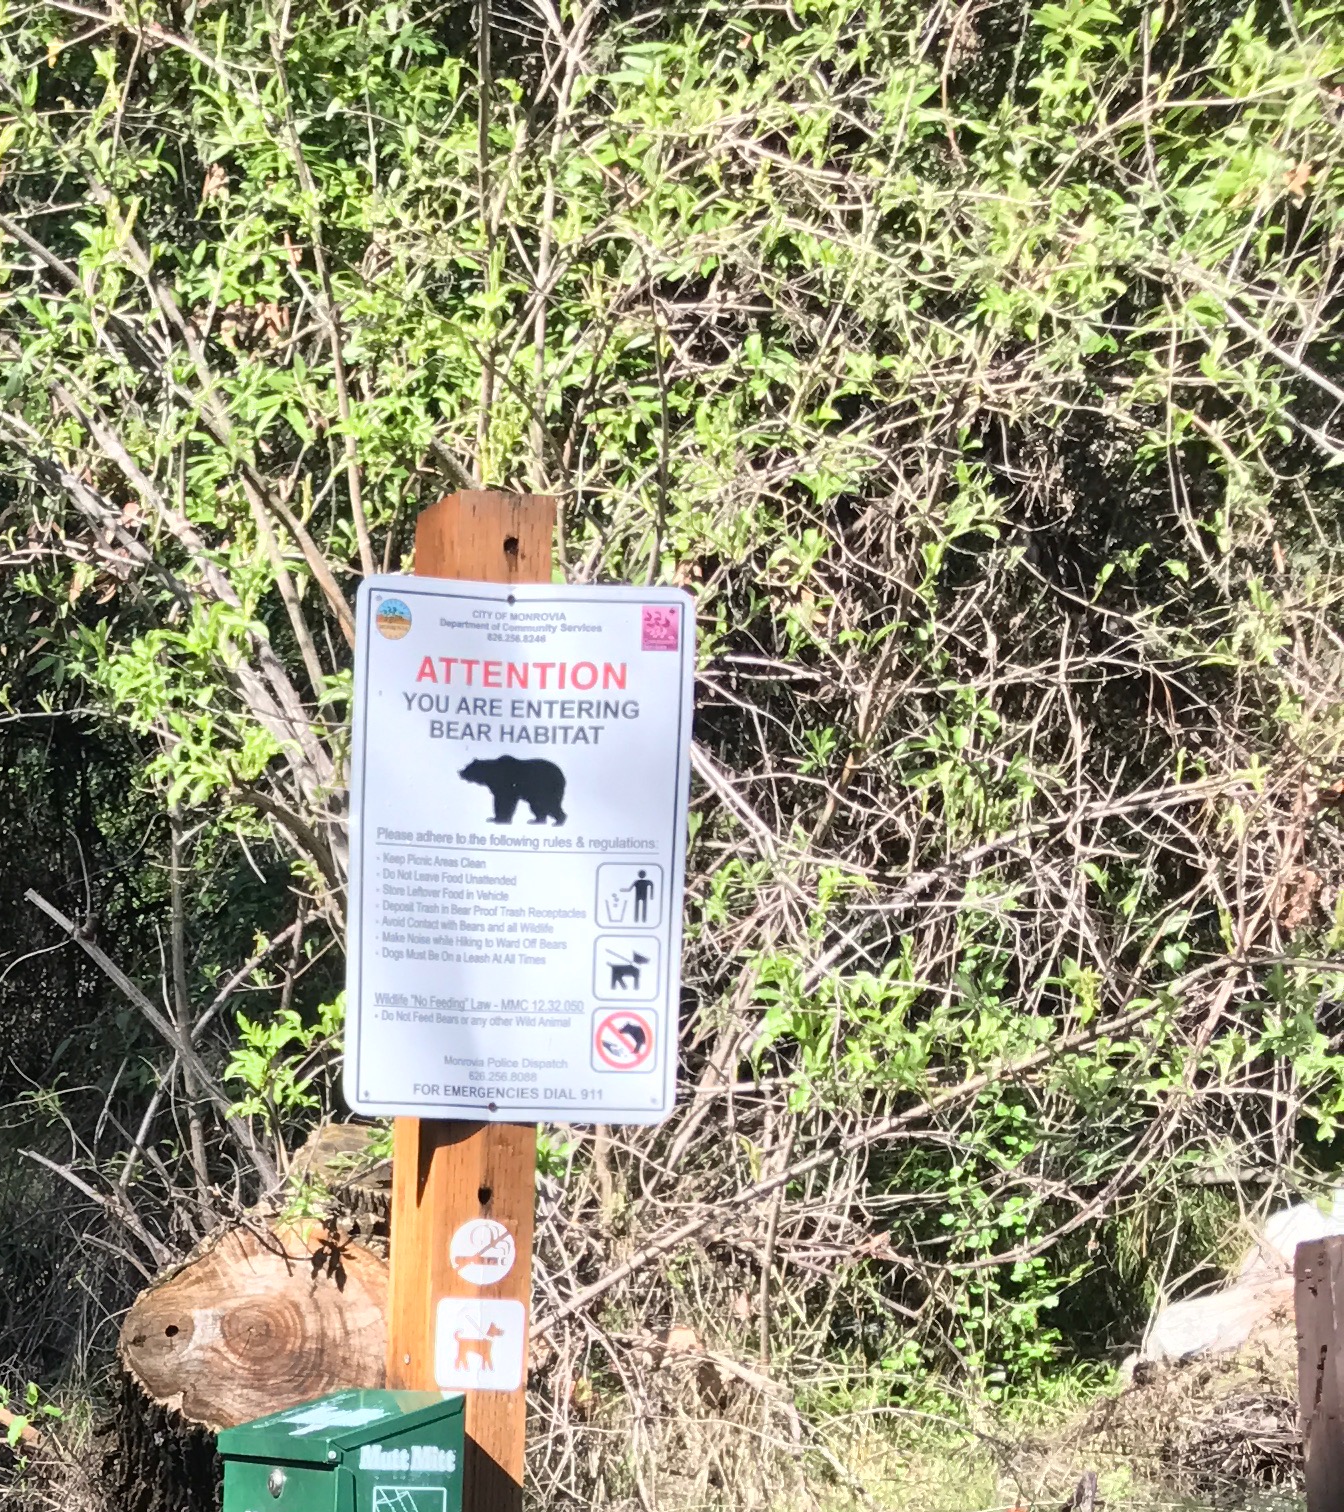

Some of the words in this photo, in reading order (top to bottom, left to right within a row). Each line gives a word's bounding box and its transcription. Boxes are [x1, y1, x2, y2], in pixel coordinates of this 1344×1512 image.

[472, 610, 492, 619] CITY
[495, 612, 508, 620] OF
[509, 612, 566, 621] MONROVIA
[440, 618, 489, 630] Department
[491, 621, 500, 630] of
[502, 623, 557, 634] Community
[561, 623, 602, 633] Services
[415, 655, 627, 690] ATTENTION
[402, 692, 450, 714] YOU
[455, 696, 503, 717] ARE
[510, 699, 640, 719] ENTERING
[429, 719, 492, 743] BEAR
[499, 723, 605, 745] HABITAT
[377, 827, 413, 841] Please
[416, 830, 453, 844] adhere
[456, 833, 466, 844] to
[469, 833, 486, 845] the
[490, 834, 540, 850] following
[543, 836, 572, 848] rules
[576, 836, 585, 848] &
[383, 853, 405, 866] Keep
[407, 854, 432, 866] Picnic
[433, 856, 458, 868] Areas
[461, 857, 486, 869] Clean
[382, 868, 395, 880] Do
[397, 869, 412, 880] Not
[414, 870, 439, 882] Leave
[441, 872, 463, 884] Food
[465, 873, 517, 886] Unattended
[382, 884, 405, 896] Store
[407, 886, 440, 898] Leftover
[442, 887, 464, 900] Food
[466, 889, 474, 900] in
[476, 889, 509, 901] Vehicle
[382, 900, 414, 913] Deposit
[416, 902, 440, 914] Trash
[441, 904, 449, 914] in
[451, 904, 471, 915] Bear
[473, 905, 498, 916] Proof
[500, 906, 526, 917] Trash
[528, 907, 587, 920] Receptacles
[382, 916, 405, 927] Avoid
[407, 917, 439, 929] Contact
[440, 920, 458, 930] with
[459, 920, 485, 932] Bears
[487, 922, 505, 933] and
[507, 922, 518, 933] all
[520, 922, 554, 934] Wildlife
[382, 931, 405, 943] Make
[407, 933, 431, 945] Noise
[432, 935, 454, 946] while
[455, 936, 483, 950] Hiking
[485, 937, 494, 948] to
[495, 937, 520, 949] Ward
[522, 938, 537, 949] Off
[539, 939, 567, 950] Bears
[382, 946, 404, 961] Dogs
[406, 949, 427, 960] Must
[428, 950, 439, 961] Be
[441, 951, 454, 962] On
[455, 954, 462, 963] a
[463, 952, 490, 963] Leash
[492, 953, 503, 964] At
[504, 953, 516, 964] All
[518, 954, 547, 965] Times
[375, 992, 408, 1005] Wildlife
[471, 998, 492, 1010] Law
[501, 999, 529, 1011] MMC
[381, 1010, 394, 1021] Do
[396, 1011, 411, 1022] Not
[413, 1011, 434, 1023] Feed
[436, 1013, 459, 1025] Bears
[460, 1016, 469, 1025] or
[471, 1017, 487, 1028] any
[489, 1016, 513, 1027] other
[515, 1016, 536, 1027] Wild
[538, 1017, 571, 1028] Animal
[444, 1055, 484, 1067] Monrovia
[487, 1057, 519, 1068] Police
[522, 1058, 568, 1070] Dispatch
[413, 1083, 440, 1096] FOR
[444, 1085, 539, 1099] EMERGENCIES
[543, 1088, 577, 1100] DIAL
[580, 1088, 603, 1100] 911
